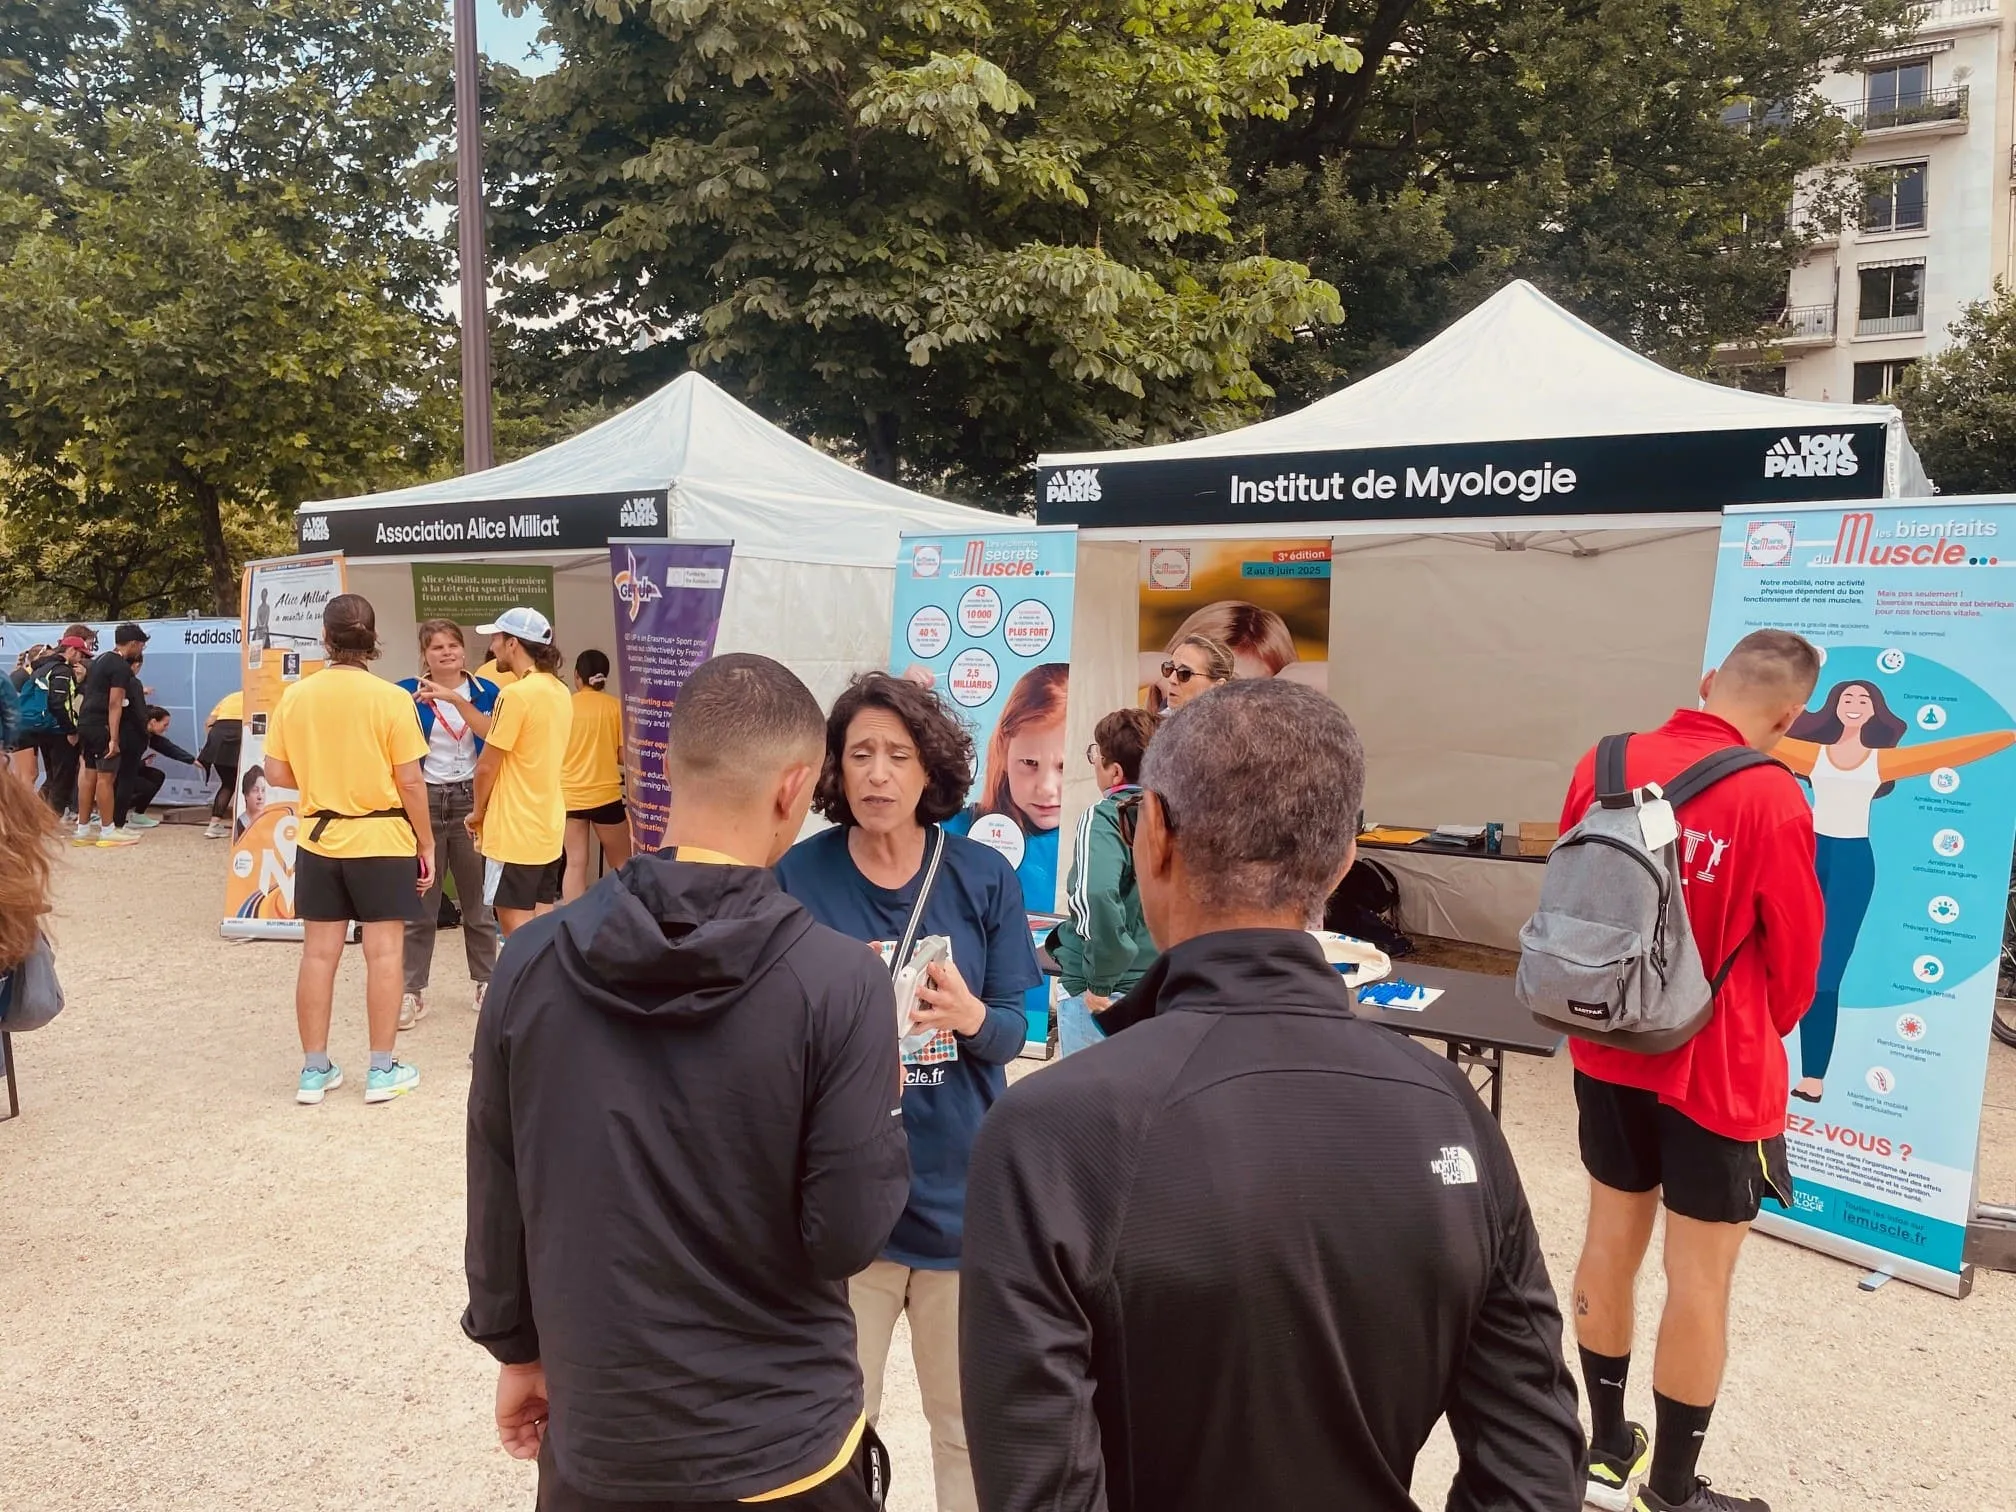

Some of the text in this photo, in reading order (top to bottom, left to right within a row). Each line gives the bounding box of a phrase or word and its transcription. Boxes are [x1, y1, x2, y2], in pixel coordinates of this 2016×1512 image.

[1764, 454, 1858, 478] PARIS
[1230, 462, 1576, 504] Institut de Myologie
[1046, 485, 1102, 503] PARIS
[620, 511, 658, 527] PARIS
[302, 528, 330, 541] PARIS
[375, 514, 560, 544] Association Alice Milliat
[1875, 518, 1998, 540] les bienfaits
[985, 547, 1039, 560] secrets
[1289, 550, 1326, 561] édition
[1814, 553, 1832, 565] du
[1246, 567, 1253, 575] 2
[1254, 568, 1266, 576] au
[1276, 566, 1295, 577] juin
[1297, 566, 1321, 576] 2025
[421, 575, 444, 584] Alice
[430, 584, 440, 592] la
[465, 584, 479, 593] du
[481, 586, 506, 595] sport
[975, 588, 986, 598] 43
[1836, 588, 1847, 596] du
[1849, 588, 1864, 596] bon
[1877, 590, 1896, 598] Mais
[274, 589, 331, 609] Alice Milliat
[464, 594, 475, 602] et
[477, 593, 519, 603] mondial
[1801, 596, 1811, 604] de
[1812, 597, 1827, 605] nos
[1008, 628, 1049, 637] PLUS FORT
[953, 680, 993, 690] MILLIARDS
[1785, 1113, 1913, 1162] EZ-VOUS ?
[1439, 1146, 1459, 1160] THE
[1844, 1200, 1871, 1215] Toutes
[1873, 1208, 1885, 1219] les
[1843, 1209, 1928, 1246] lemuscle.fr
